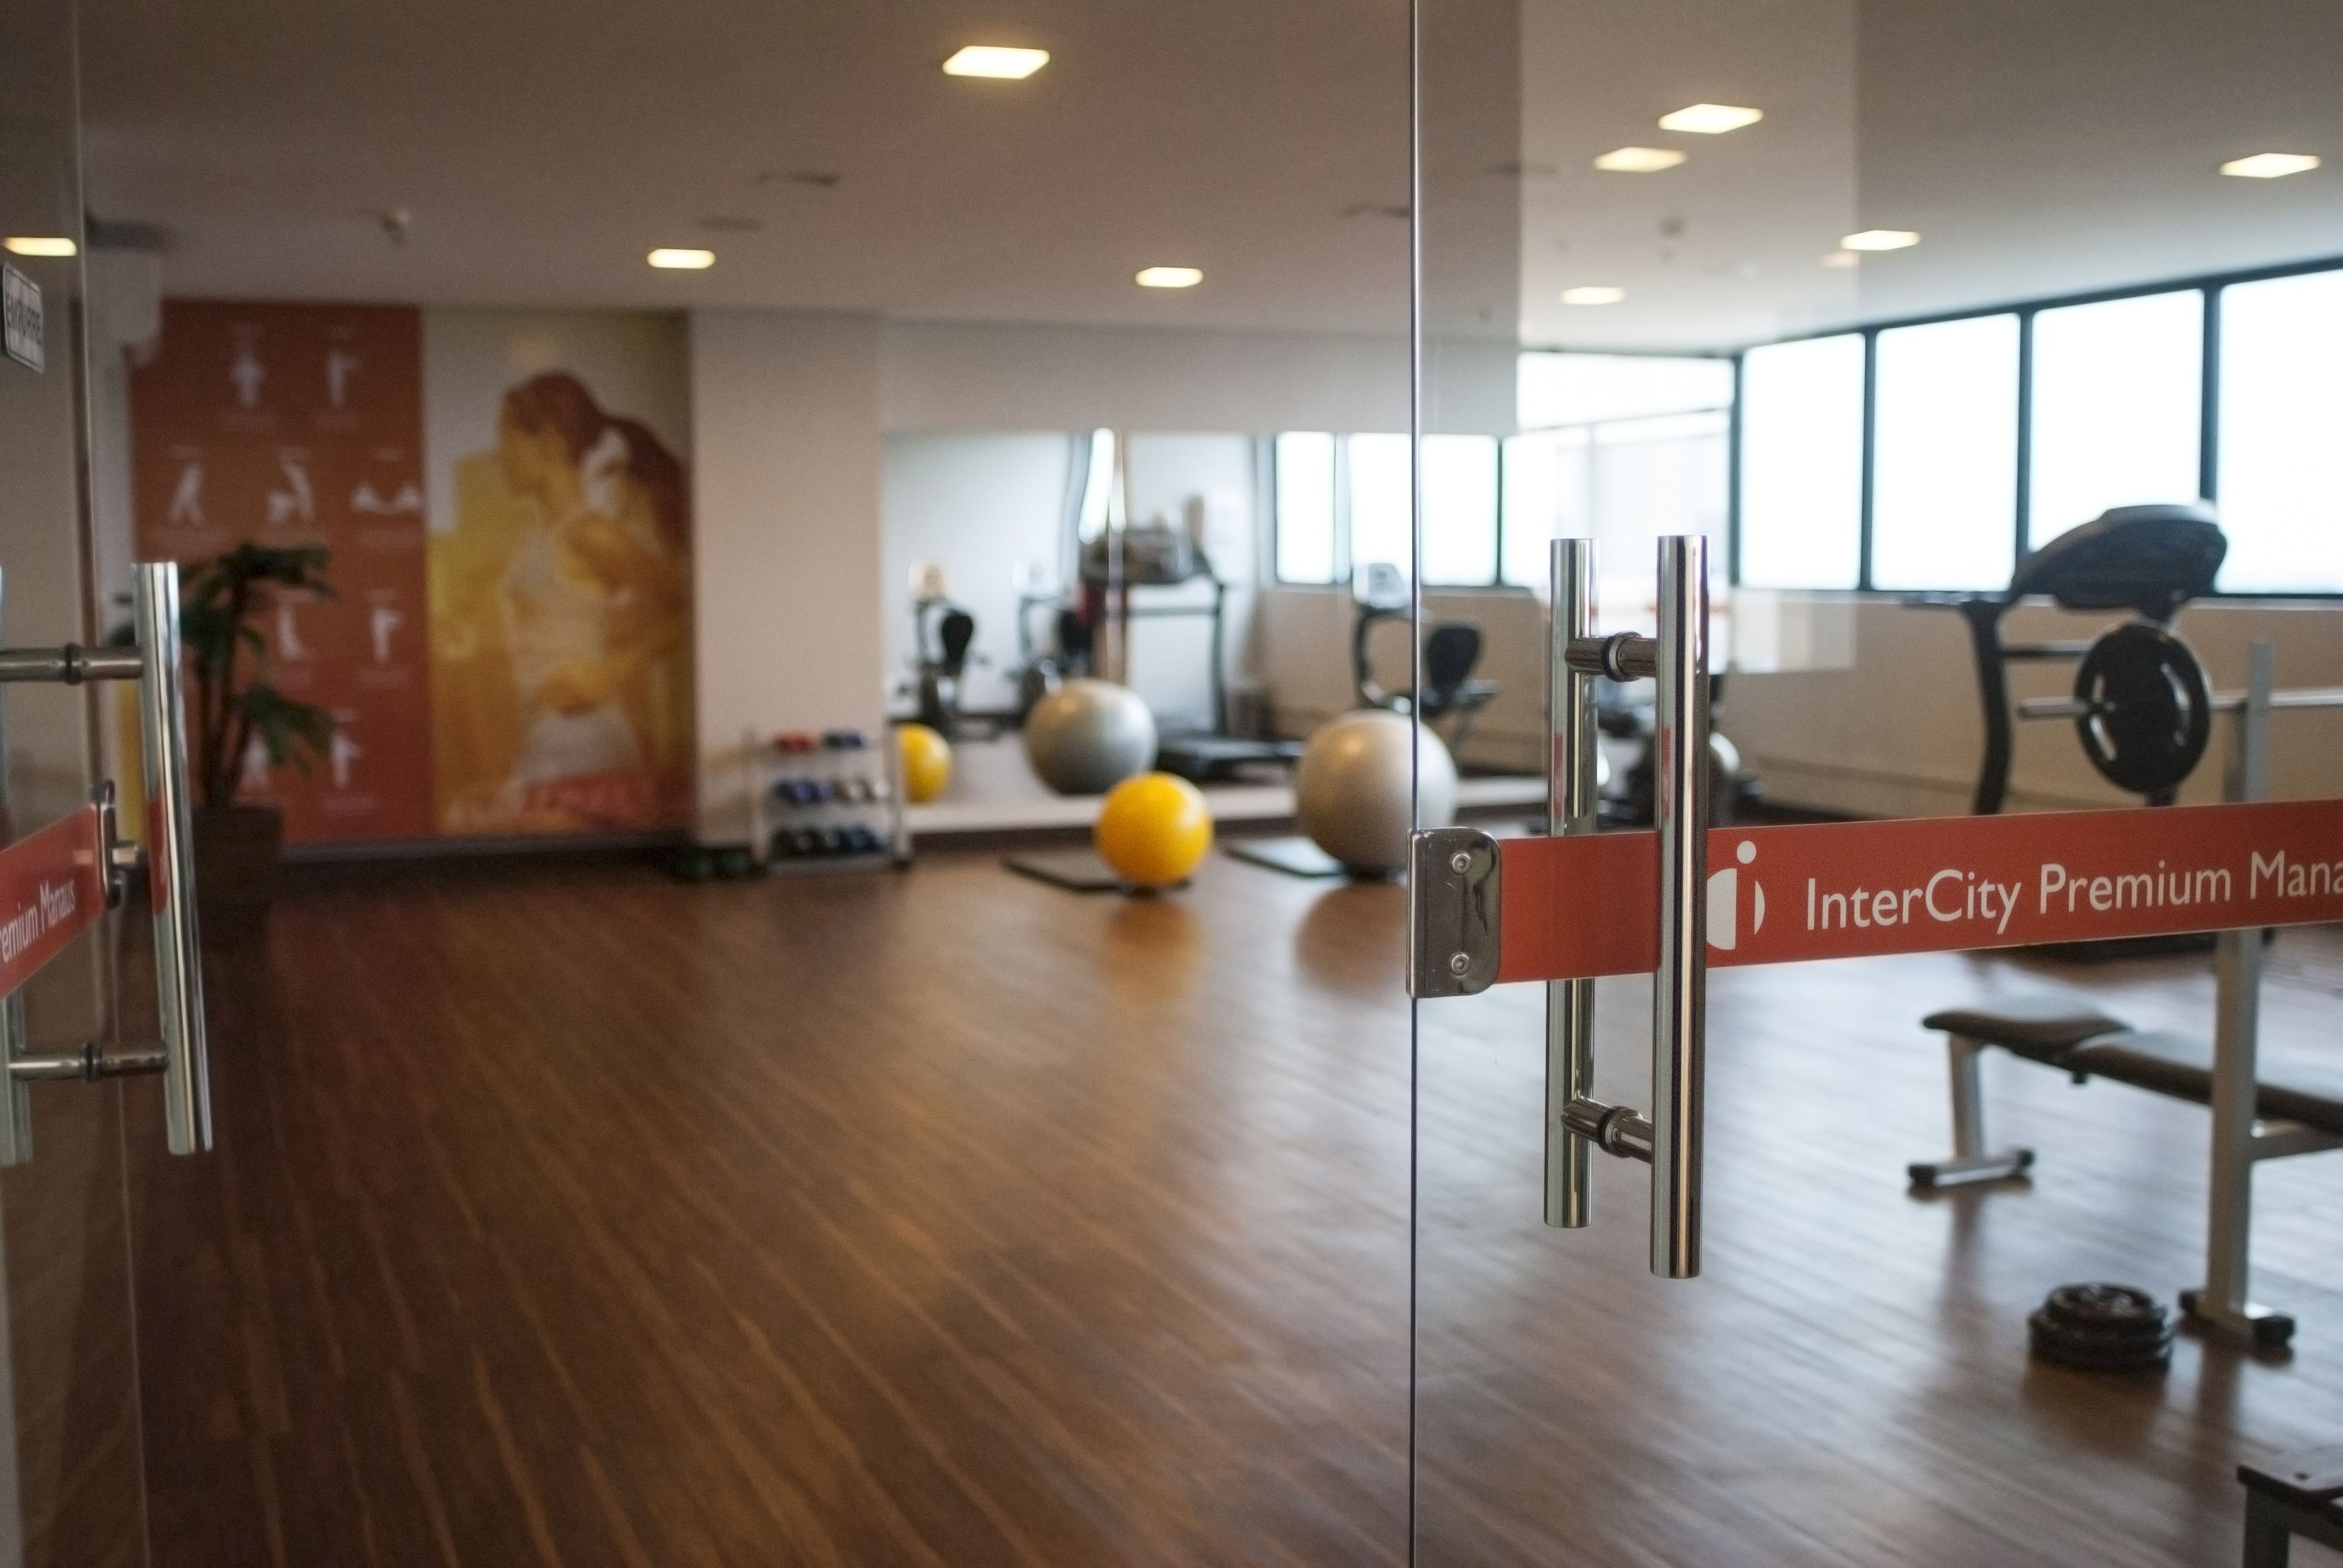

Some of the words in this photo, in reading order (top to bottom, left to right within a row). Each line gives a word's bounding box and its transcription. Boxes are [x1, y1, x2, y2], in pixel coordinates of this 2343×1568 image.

[1807, 869, 2022, 934] InterCity
[2040, 862, 2231, 914] Premium
[0, 902, 38, 963] emium
